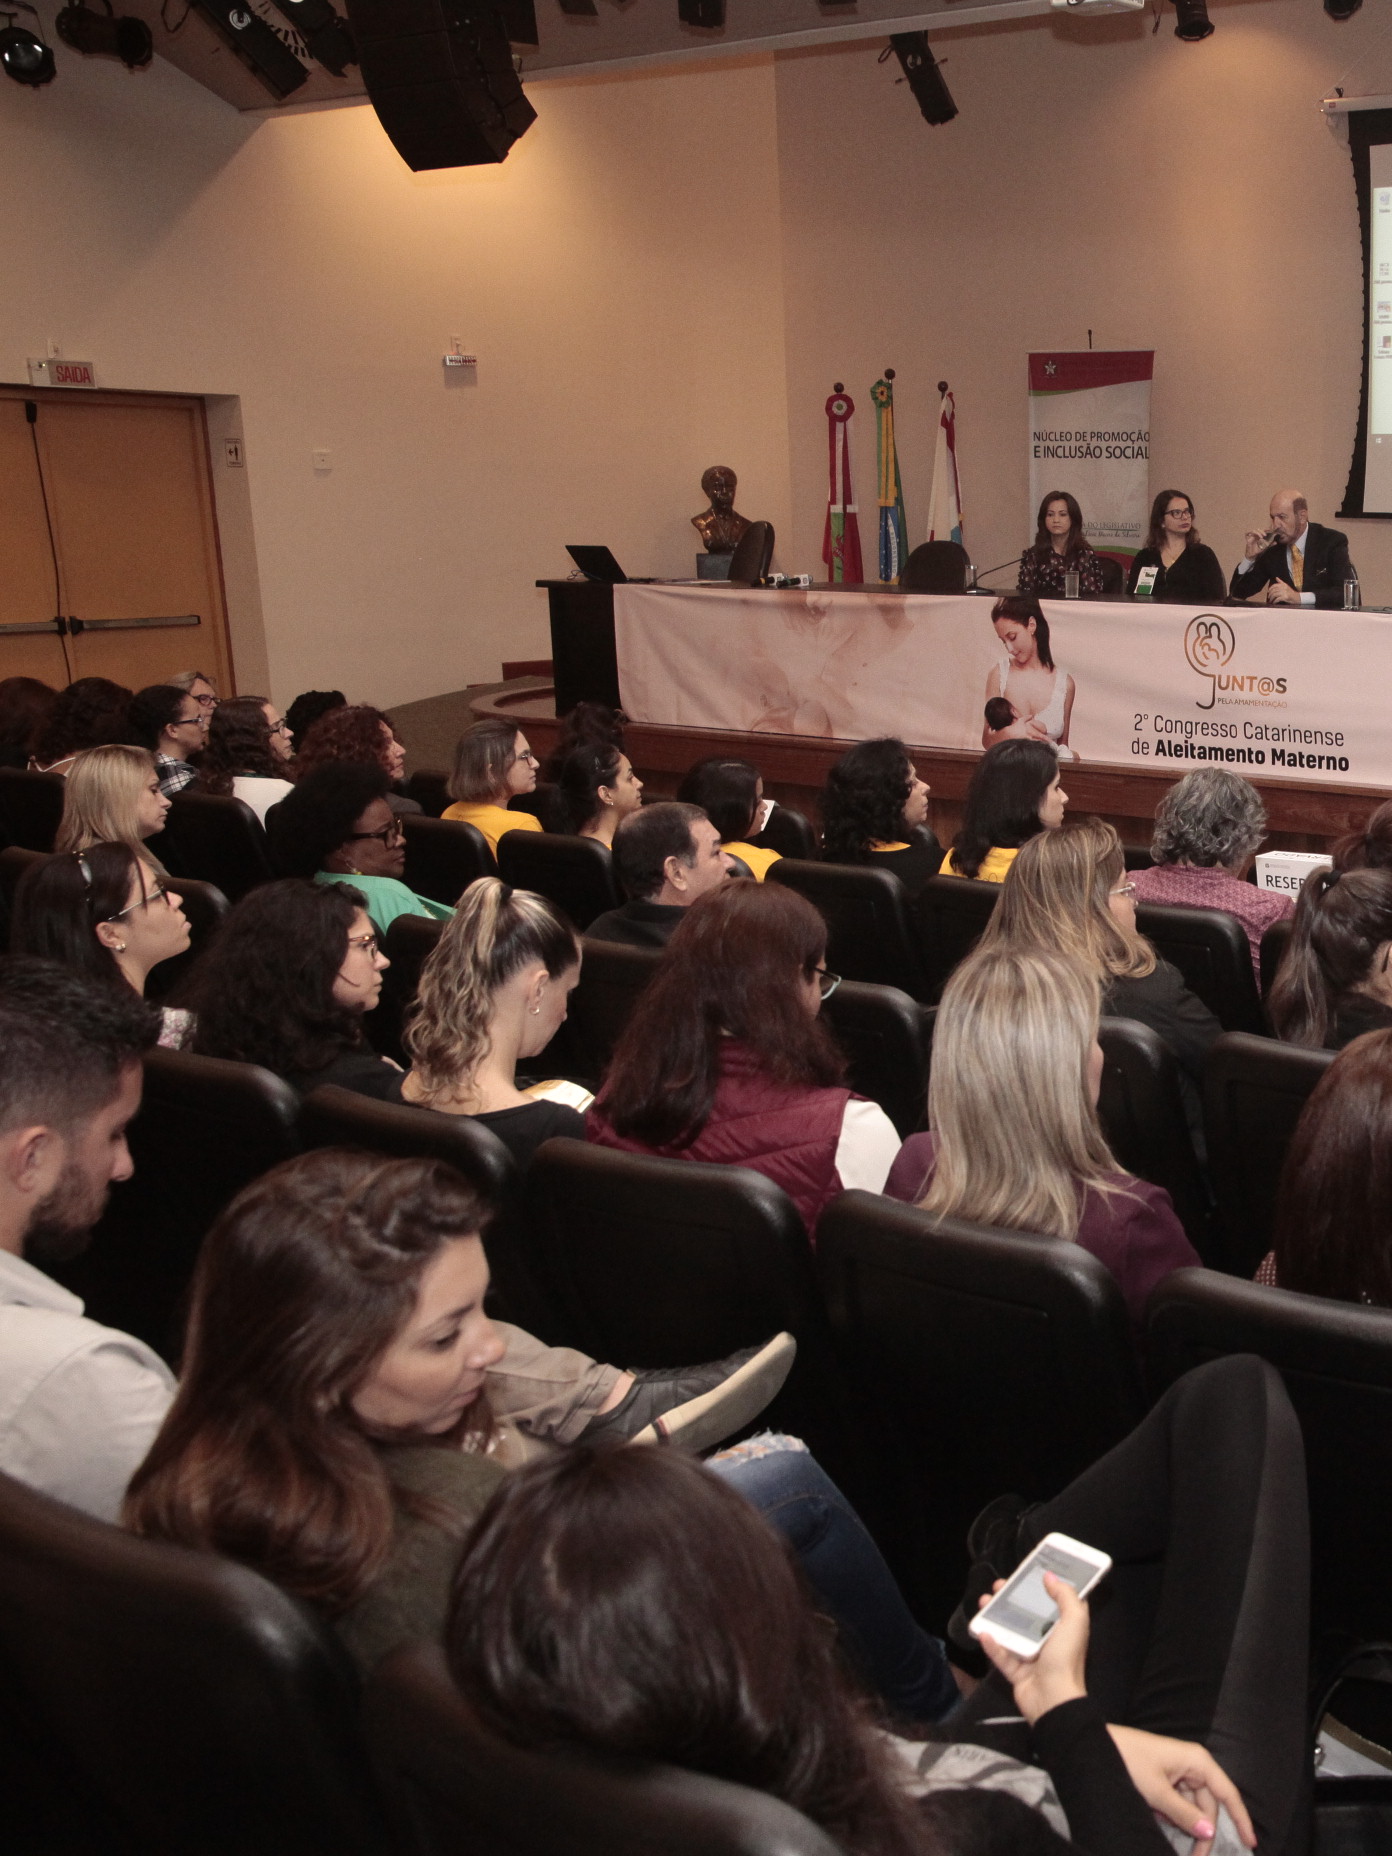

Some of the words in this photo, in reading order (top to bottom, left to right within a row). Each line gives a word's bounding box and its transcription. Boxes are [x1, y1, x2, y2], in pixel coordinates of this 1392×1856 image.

[1033, 430, 1072, 442] NÚCLEO
[1075, 432, 1087, 442] DE
[1090, 430, 1150, 444] PROMOÇÃO
[1034, 445, 1041, 458] E
[1043, 443, 1102, 459] INCLUSÃO
[1105, 446, 1150, 459] SOCIAL
[1234, 699, 1288, 709] AMAMENTAÇÃO
[1154, 714, 1238, 739] Congresso
[1243, 722, 1344, 747] Catarinense
[1131, 737, 1150, 756] de
[1154, 739, 1266, 765] Aleitamento
[1271, 748, 1349, 772] Materno
